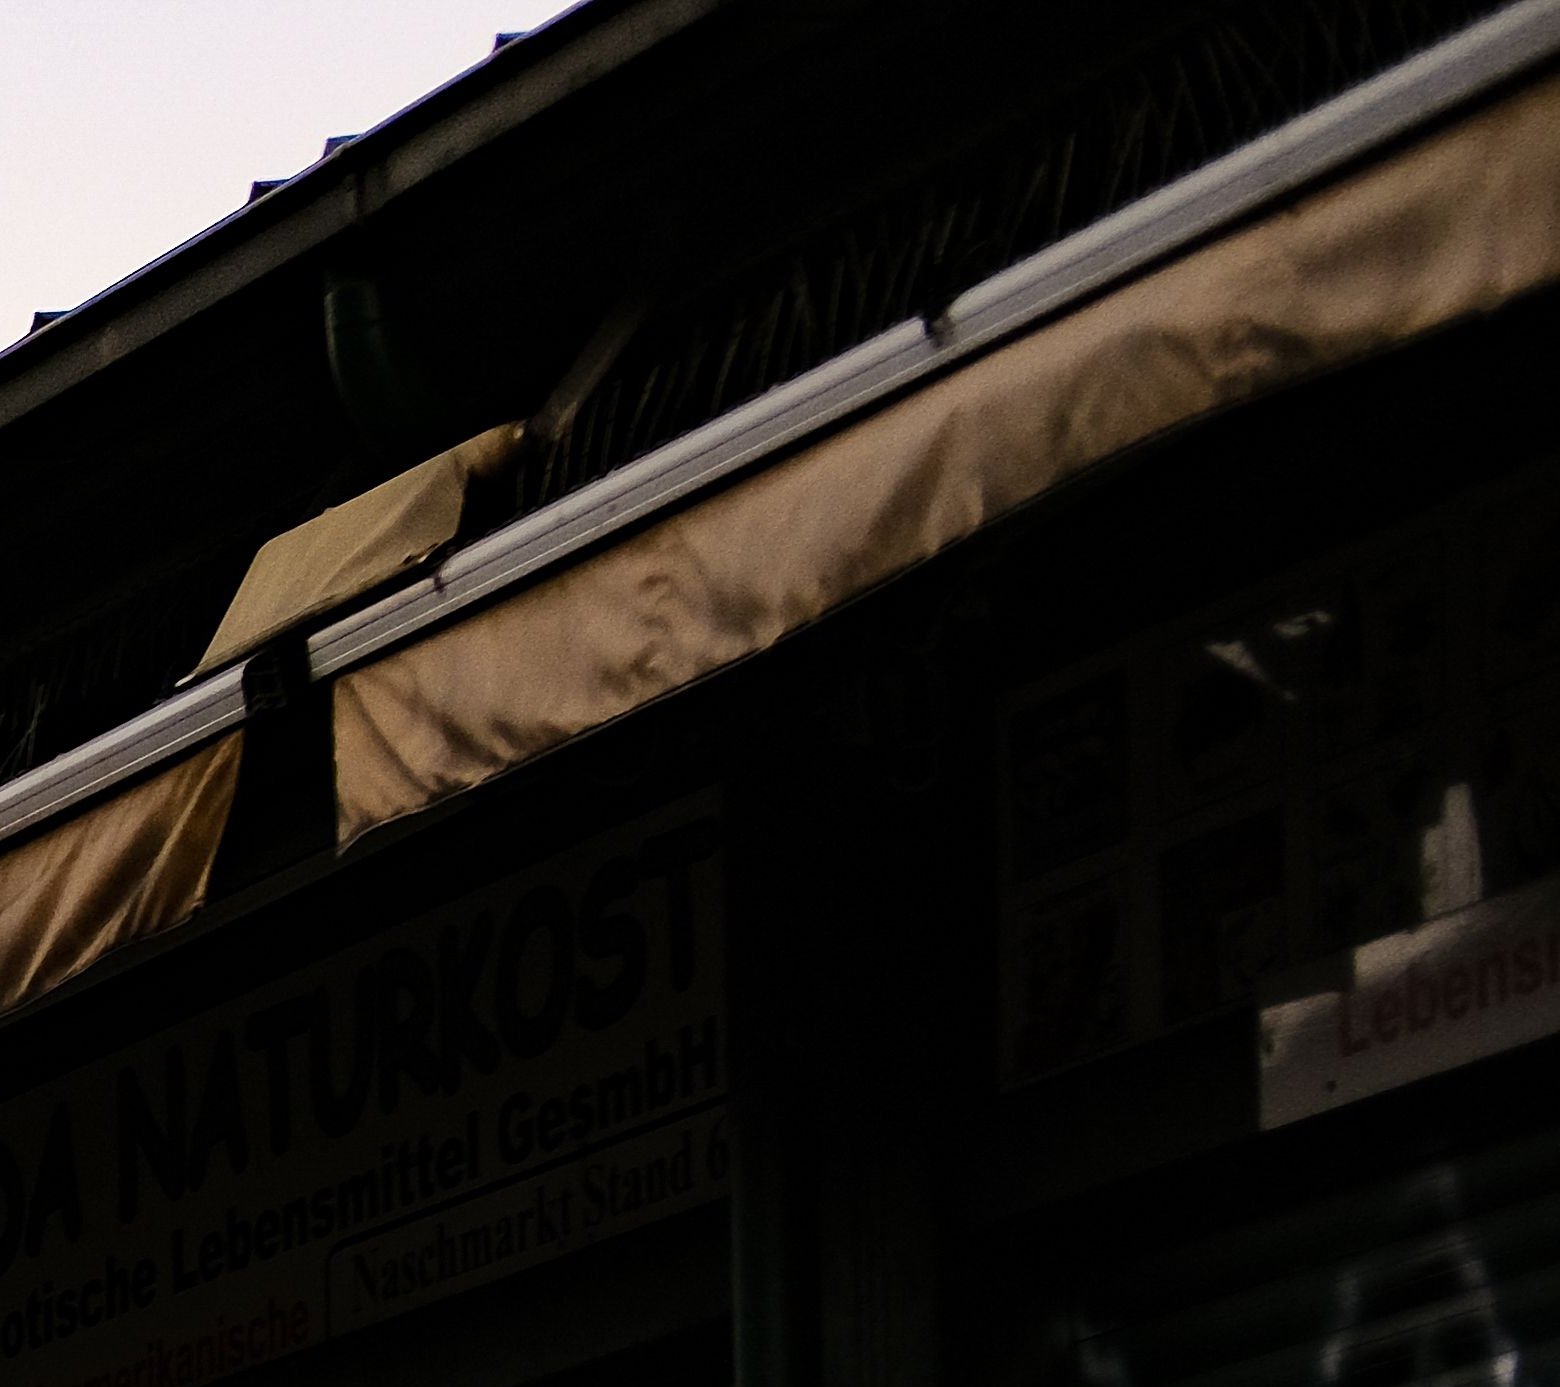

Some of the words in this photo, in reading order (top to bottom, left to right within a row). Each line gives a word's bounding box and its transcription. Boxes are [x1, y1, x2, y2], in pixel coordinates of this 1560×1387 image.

[119, 832, 719, 1221] NATURKOST
[173, 1111, 480, 1296] Lebensmittel
[499, 1015, 717, 1162] GesmbH
[349, 1187, 573, 1315] Naschmarkt
[582, 1129, 693, 1230] Stand
